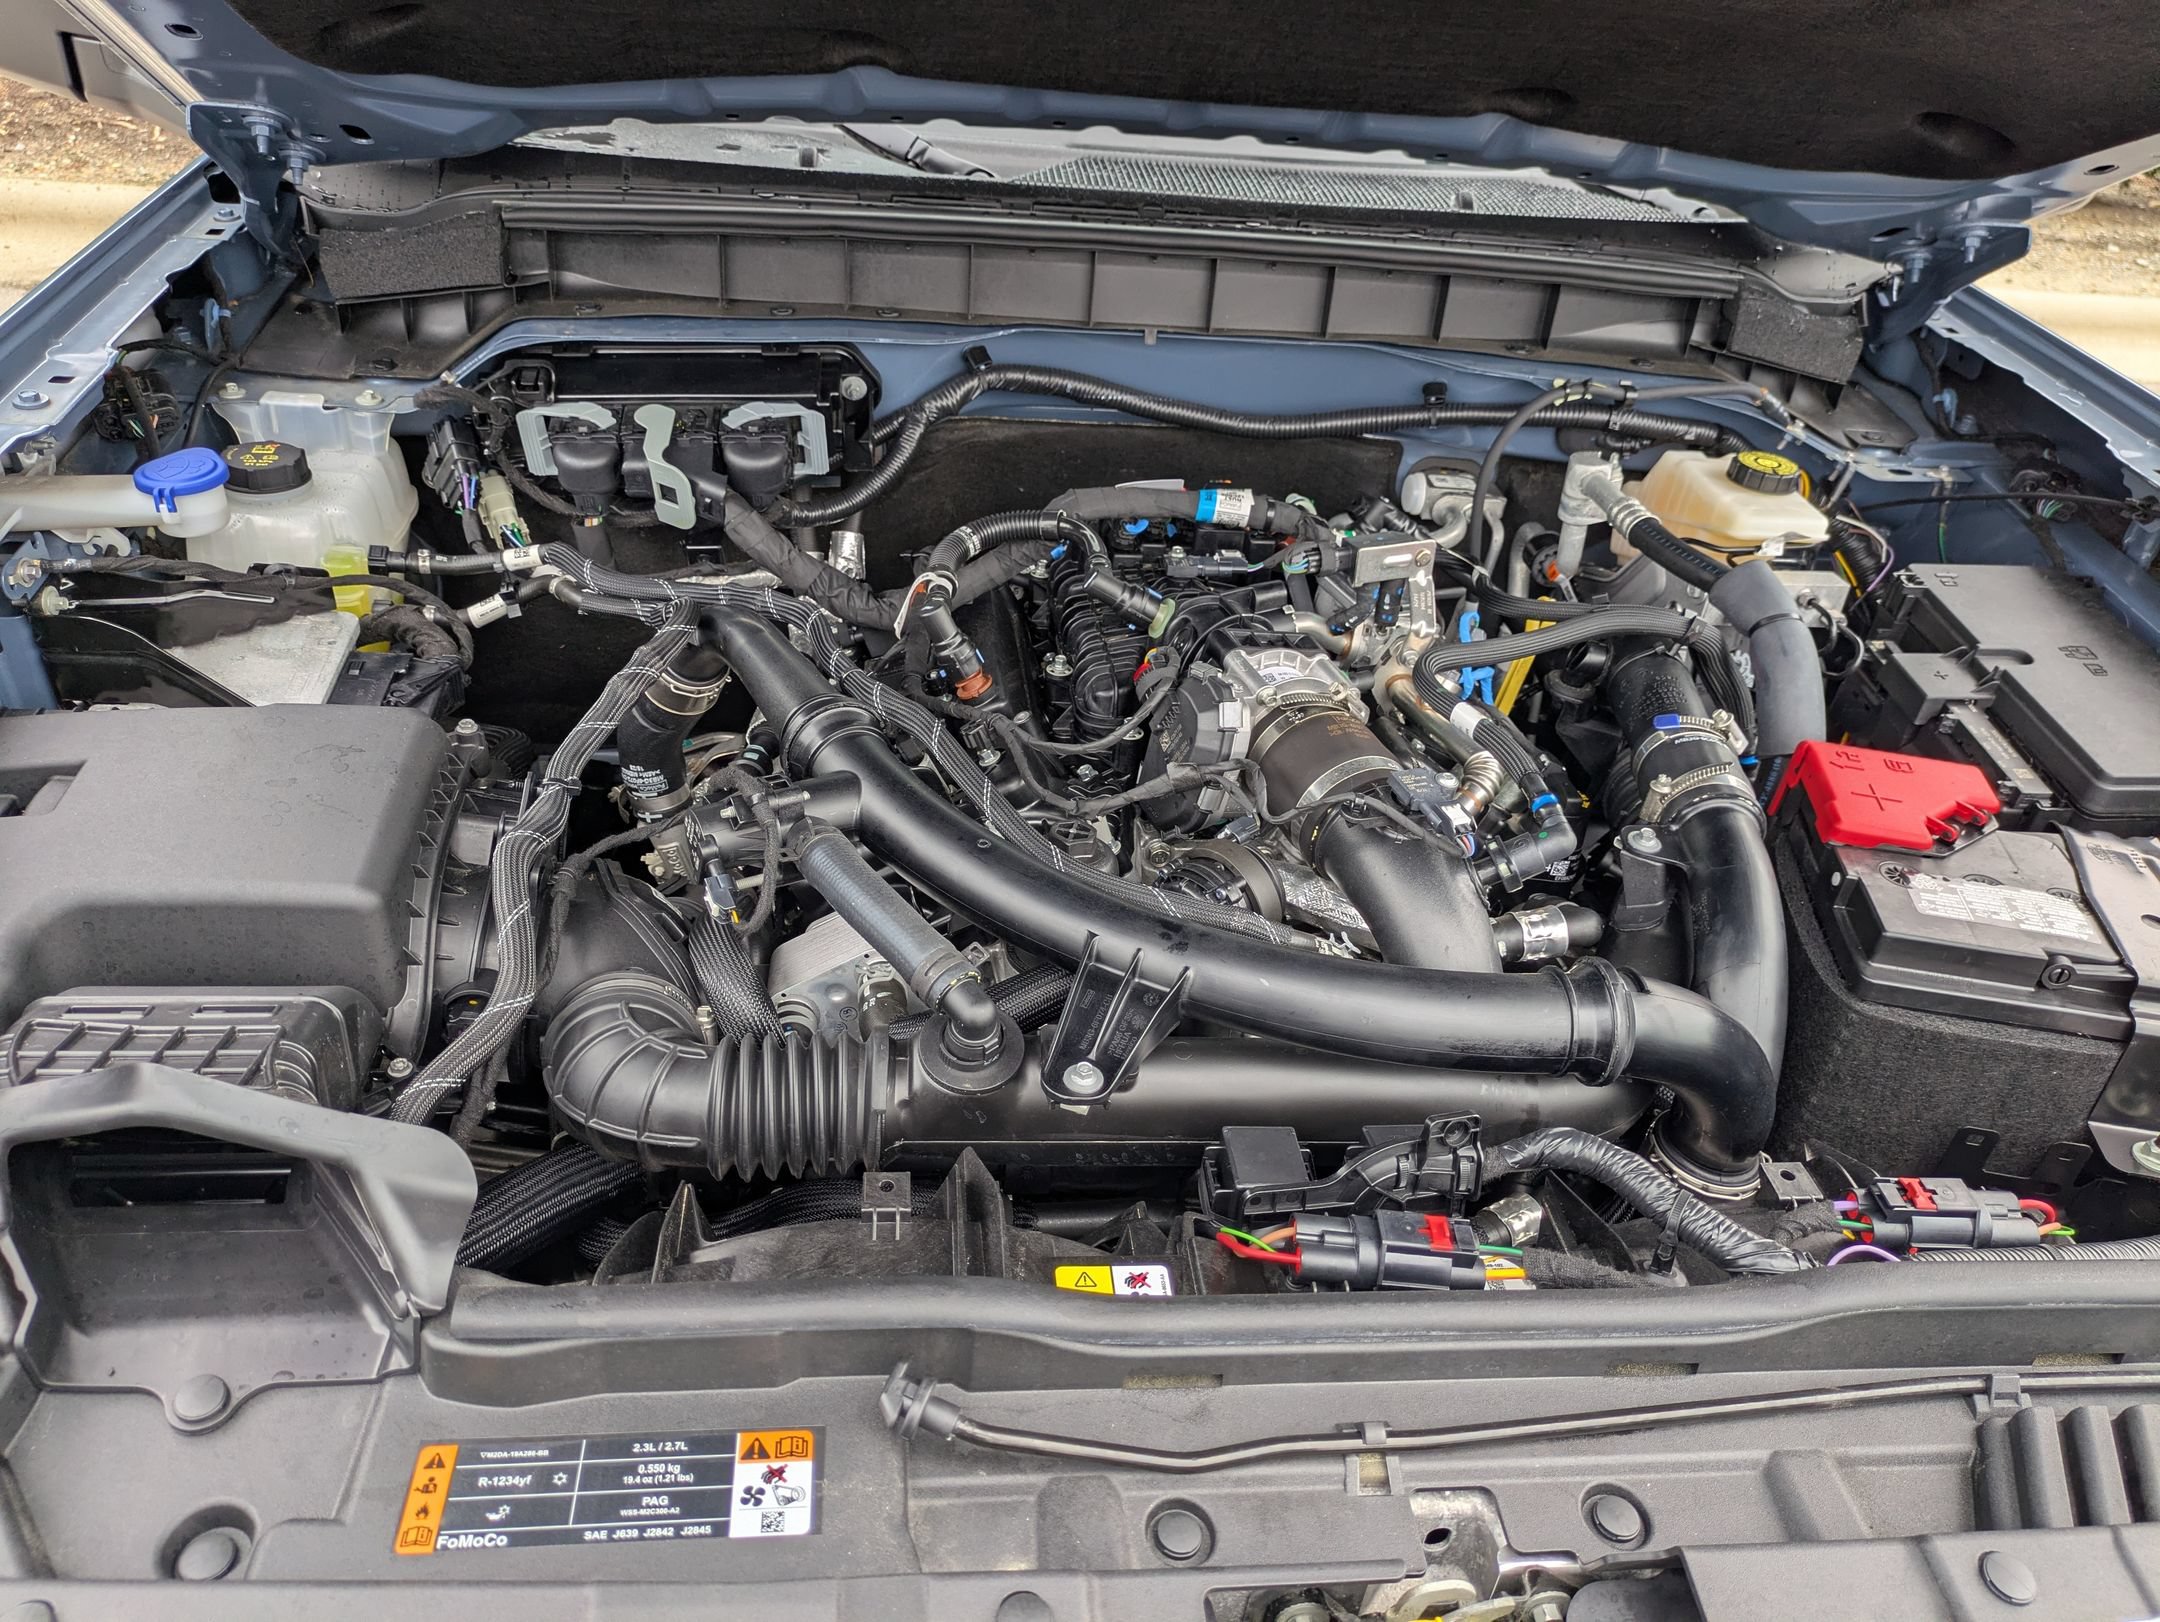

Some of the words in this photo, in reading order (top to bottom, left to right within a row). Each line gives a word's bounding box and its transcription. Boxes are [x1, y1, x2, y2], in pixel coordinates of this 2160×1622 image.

[632, 1443, 656, 1452] 2.3L
[664, 1441, 688, 1451] 2.7L
[638, 1463, 666, 1474] 0.550
[667, 1463, 681, 1474] kg
[478, 1475, 532, 1488] R-1234yf
[623, 1475, 640, 1485] 19.4
[642, 1476, 652, 1484] oz
[654, 1474, 675, 1485] (1.21
[677, 1472, 694, 1483] lbs)
[642, 1496, 669, 1506] PAG
[584, 1530, 608, 1540] SAE
[612, 1528, 639, 1539] J639
[643, 1527, 674, 1538] J2842
[680, 1525, 712, 1536] J2845
[436, 1534, 508, 1549] FoMoCo
